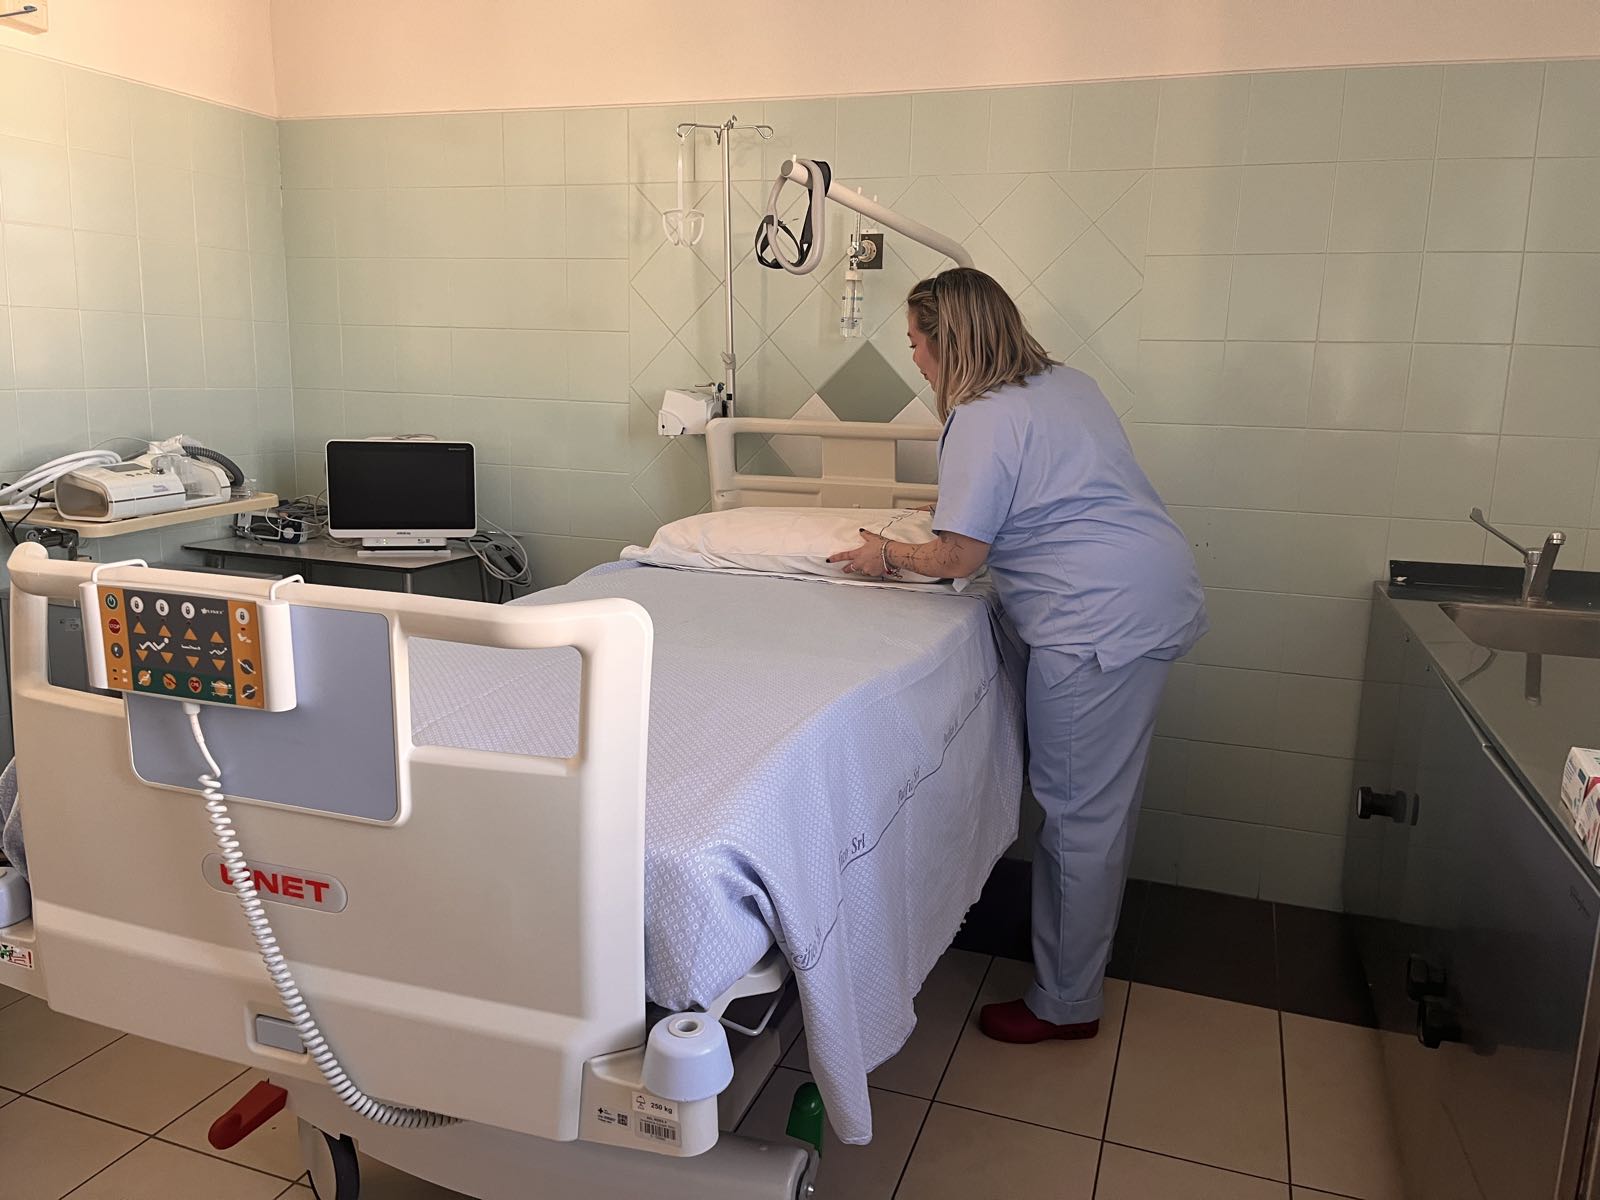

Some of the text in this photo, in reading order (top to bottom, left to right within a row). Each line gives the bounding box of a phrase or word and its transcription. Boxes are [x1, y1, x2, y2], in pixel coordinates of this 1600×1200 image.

[851, 832, 865, 854] Srl
[219, 863, 330, 903] LNET
[650, 1102, 673, 1115] 250 kg
